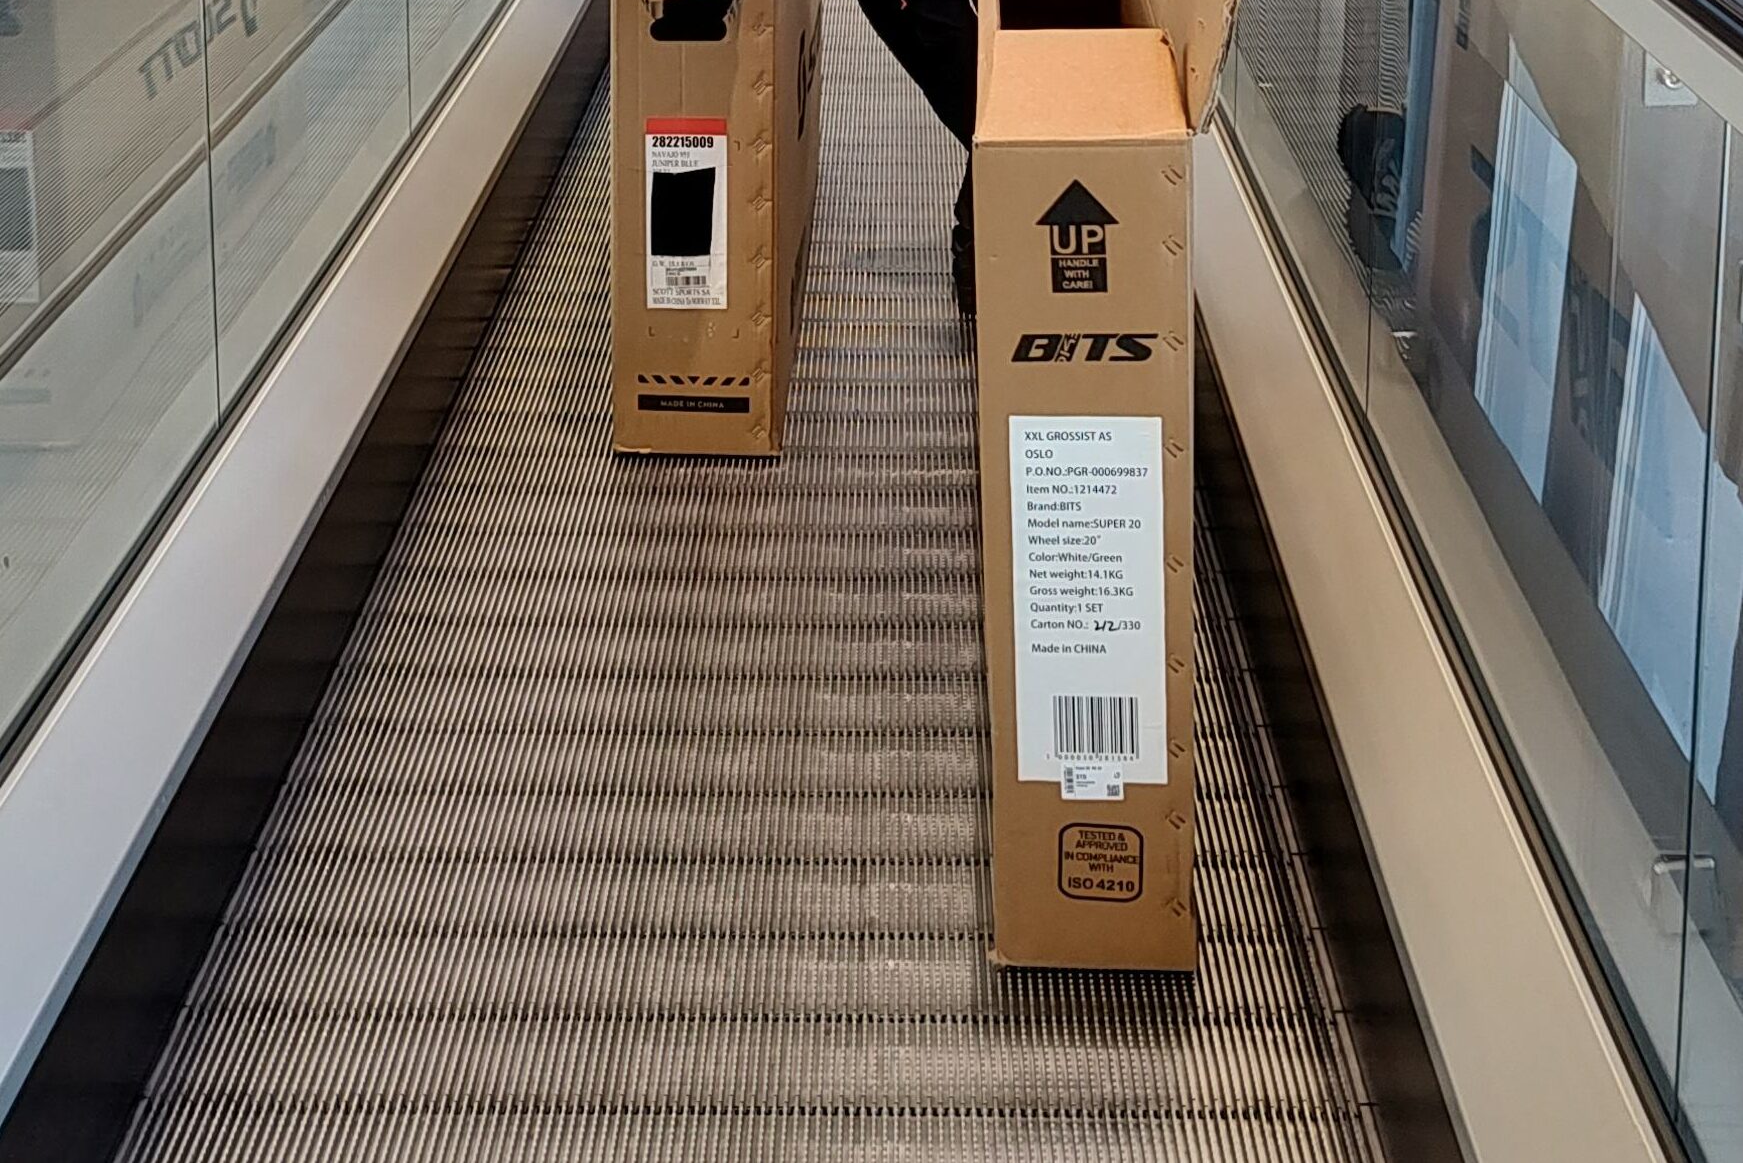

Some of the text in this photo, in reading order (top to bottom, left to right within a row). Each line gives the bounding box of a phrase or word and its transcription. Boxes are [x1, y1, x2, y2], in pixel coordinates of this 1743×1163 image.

[652, 136, 714, 148] 282215009
[1052, 225, 1104, 254] UP
[1059, 259, 1099, 267] HANDLE
[1064, 269, 1089, 278] WITH
[1025, 432, 1112, 441] XXL GROSSIST AS
[1025, 449, 1053, 459] OSLO
[1026, 485, 1050, 494] Item
[1027, 502, 1081, 511] Brand:BITS
[1028, 519, 1141, 529] Model name:SUPER 20
[1028, 536, 1060, 545] Wheel
[1029, 553, 1122, 562] Color:White/Green
[1030, 570, 1123, 581] Net weight:14.1KG
[1030, 586, 1134, 597] Gross weight:16.3KG
[1031, 603, 1103, 614] Quantity:1 SET
[1031, 620, 1064, 629] Carton
[1032, 644, 1106, 654] Made in CHINA
[1078, 830, 1125, 841] TESTED &
[1076, 841, 1128, 851] APPROVED
[1064, 852, 1139, 864] IN COMPLIANCE
[1089, 863, 1114, 872] WITH
[1068, 877, 1135, 892] ISO 4210
